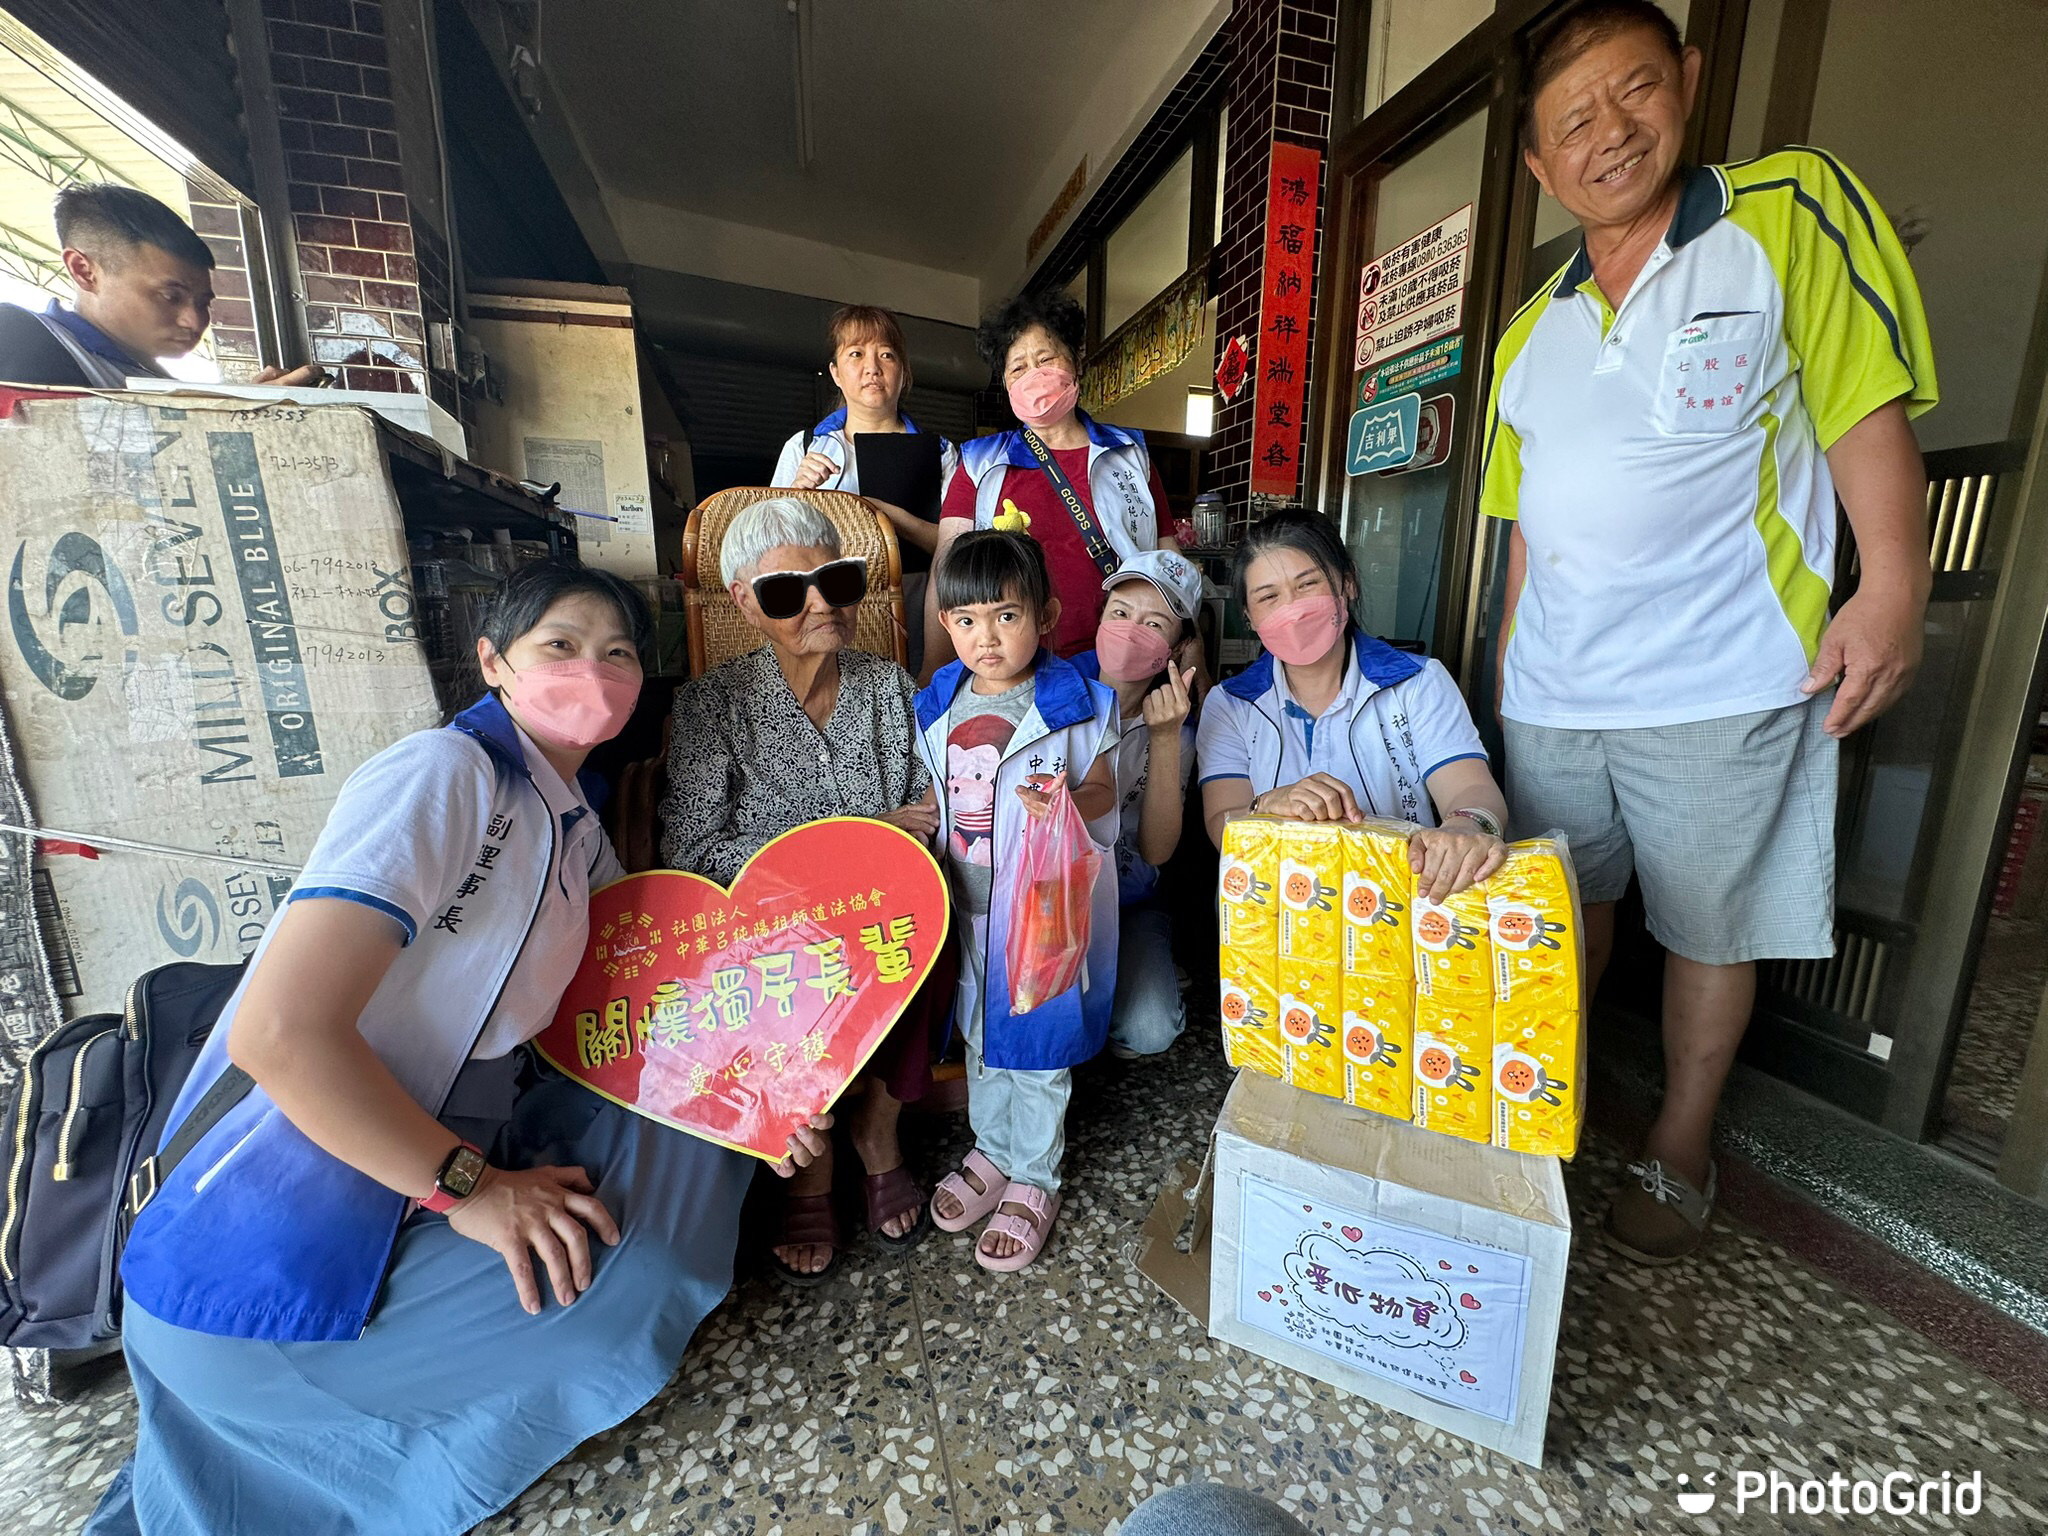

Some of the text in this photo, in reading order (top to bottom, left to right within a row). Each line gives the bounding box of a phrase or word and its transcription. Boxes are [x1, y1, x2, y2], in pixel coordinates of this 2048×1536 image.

[1382, 225, 1443, 270] 吸菸有害健康
[1377, 273, 1458, 325] 及禁止供應其菸品
[1379, 255, 1461, 308] 未滿18歲不得吸菸
[1677, 354, 1748, 371] 七股區
[1675, 382, 1744, 410] 里長聯誼會
[270, 456, 339, 472] 721-3573
[1024, 429, 1048, 462] GOODS
[1060, 488, 1091, 531] GOODS
[284, 557, 378, 576] 06-7942013
[230, 483, 304, 730] ORIGINAL BLUE
[373, 567, 420, 643] BOX
[184, 640, 257, 785] MILD
[434, 814, 513, 934] 副理事長
[671, 905, 748, 937] 社團法人
[676, 888, 887, 959] 中華呂純陽祖師道法協會
[575, 913, 917, 1071] 關懷獨居長輩
[687, 1028, 832, 1096] 愛心守護
[1305, 1262, 1439, 1329] 愛心物資
